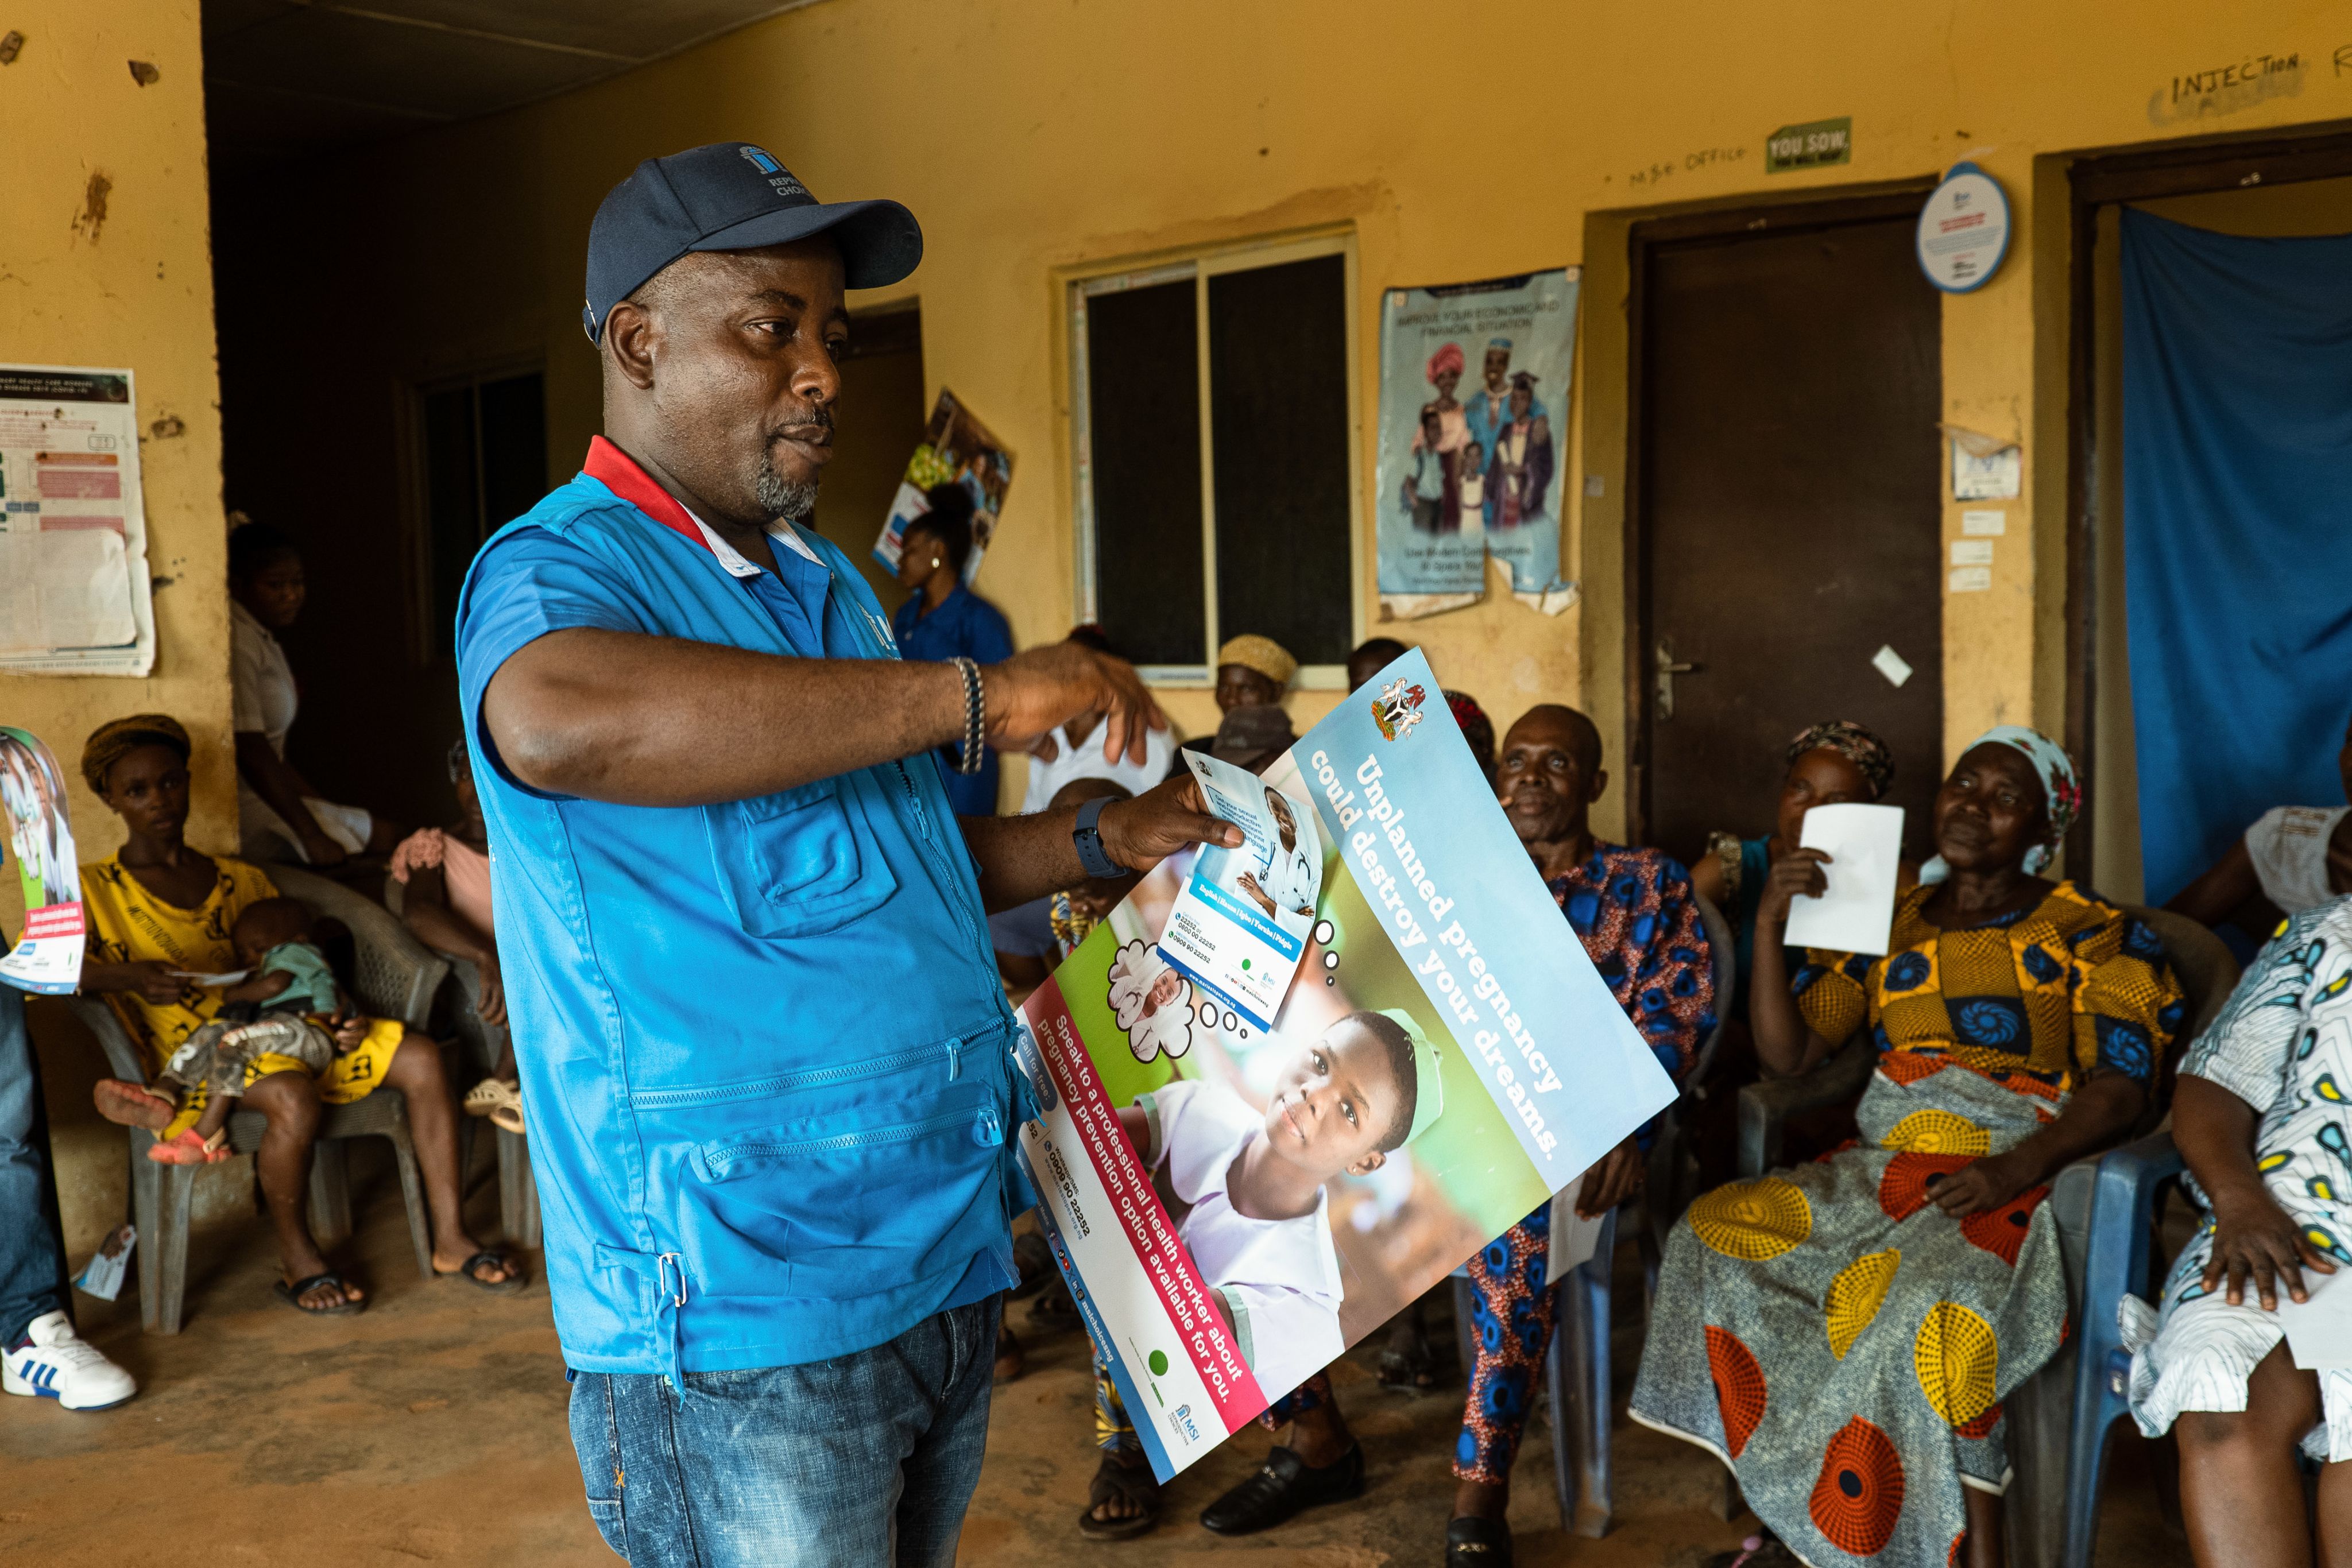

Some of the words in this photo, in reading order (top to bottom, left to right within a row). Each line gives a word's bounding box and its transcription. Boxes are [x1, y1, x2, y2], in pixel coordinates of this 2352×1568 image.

[2172, 53, 2299, 104] INJECTION
[1770, 136, 1803, 158] YOU
[1443, 308, 1474, 322] YOUR
[1477, 318, 1533, 332] SITUATION
[1227, 807, 1261, 828] reproductive
[1239, 808, 1257, 820] sexual
[1245, 833, 1267, 853] language
[1254, 834, 1264, 843] your
[1181, 916, 1196, 930] 22252
[1199, 884, 1218, 901] English
[1220, 897, 1237, 914] Hausa
[1239, 909, 1251, 923] Igbo
[1254, 920, 1274, 938] Yoruba
[1275, 932, 1293, 950] Pidgin
[1356, 753, 1455, 923] Unplanned
[1438, 919, 1563, 1093] pregnancy
[1173, 935, 1186, 947] 0909
[1186, 944, 1194, 952] 90
[1194, 949, 1210, 963] 22252
[1199, 936, 1216, 951] 22252
[1311, 750, 1364, 832] could
[1351, 831, 1429, 948] destroy
[1417, 948, 1480, 1025] your
[1474, 1029, 1558, 1162] dreams.
[1189, 973, 1236, 1009] www.mariestopes.org.ng
[1056, 1015, 1082, 1068] Speak
[1021, 1036, 1032, 1058] Call
[1029, 1057, 1039, 1073] for
[1037, 1074, 1050, 1100] free:
[1079, 1067, 1090, 1087] to
[1089, 1089, 1098, 1102] a
[1055, 1146, 1079, 1197] Whatsapp/SMS:
[1092, 1102, 1151, 1207] professional
[1037, 1019, 1082, 1104] pregnancy
[1076, 1105, 1124, 1195] prevention
[1121, 1196, 1152, 1252] option
[1150, 1253, 1193, 1332] available
[1191, 1331, 1210, 1359] for
[1203, 1361, 1229, 1404] you.
[1045, 1158, 1083, 1240] www.mariestopes.org.ng
[1049, 1152, 1065, 1182] 0909
[1063, 1182, 1073, 1198] 90
[1070, 1199, 1090, 1236] 22252
[1146, 1205, 1178, 1263] health
[1175, 1261, 1213, 1325] worker
[1082, 1300, 1114, 1362] msichoicesng
[1209, 1322, 1244, 1383] about
[1167, 1414, 1179, 1434] CHOICES
[1171, 1412, 1189, 1447] REPRODUCTIVE
[1185, 1418, 1200, 1442] MSI
